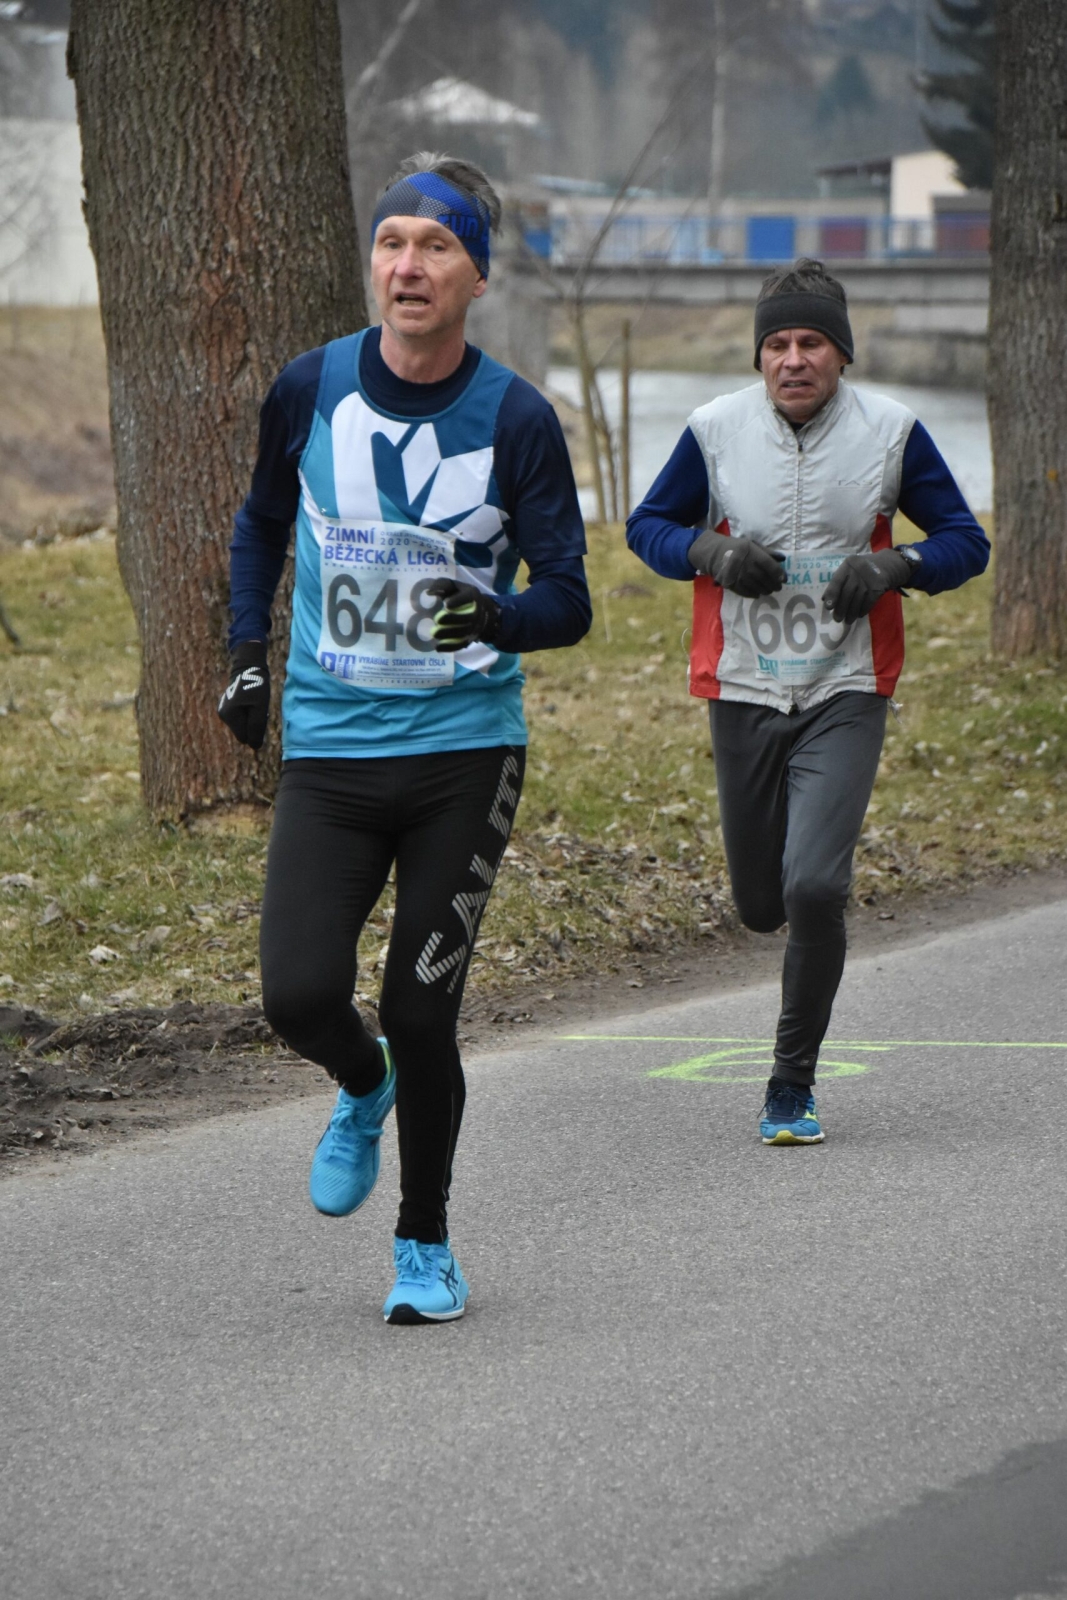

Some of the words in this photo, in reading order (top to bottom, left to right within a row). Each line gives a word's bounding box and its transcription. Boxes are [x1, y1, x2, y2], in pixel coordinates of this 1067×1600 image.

[325, 526, 376, 545] ZIMNÍ
[324, 545, 398, 566] BĚŽECKÁ
[408, 550, 448, 566] LIGA
[327, 573, 444, 653] 648
[392, 658, 425, 667] STARTOVNÍ
[428, 658, 446, 667] ČÍSLA
